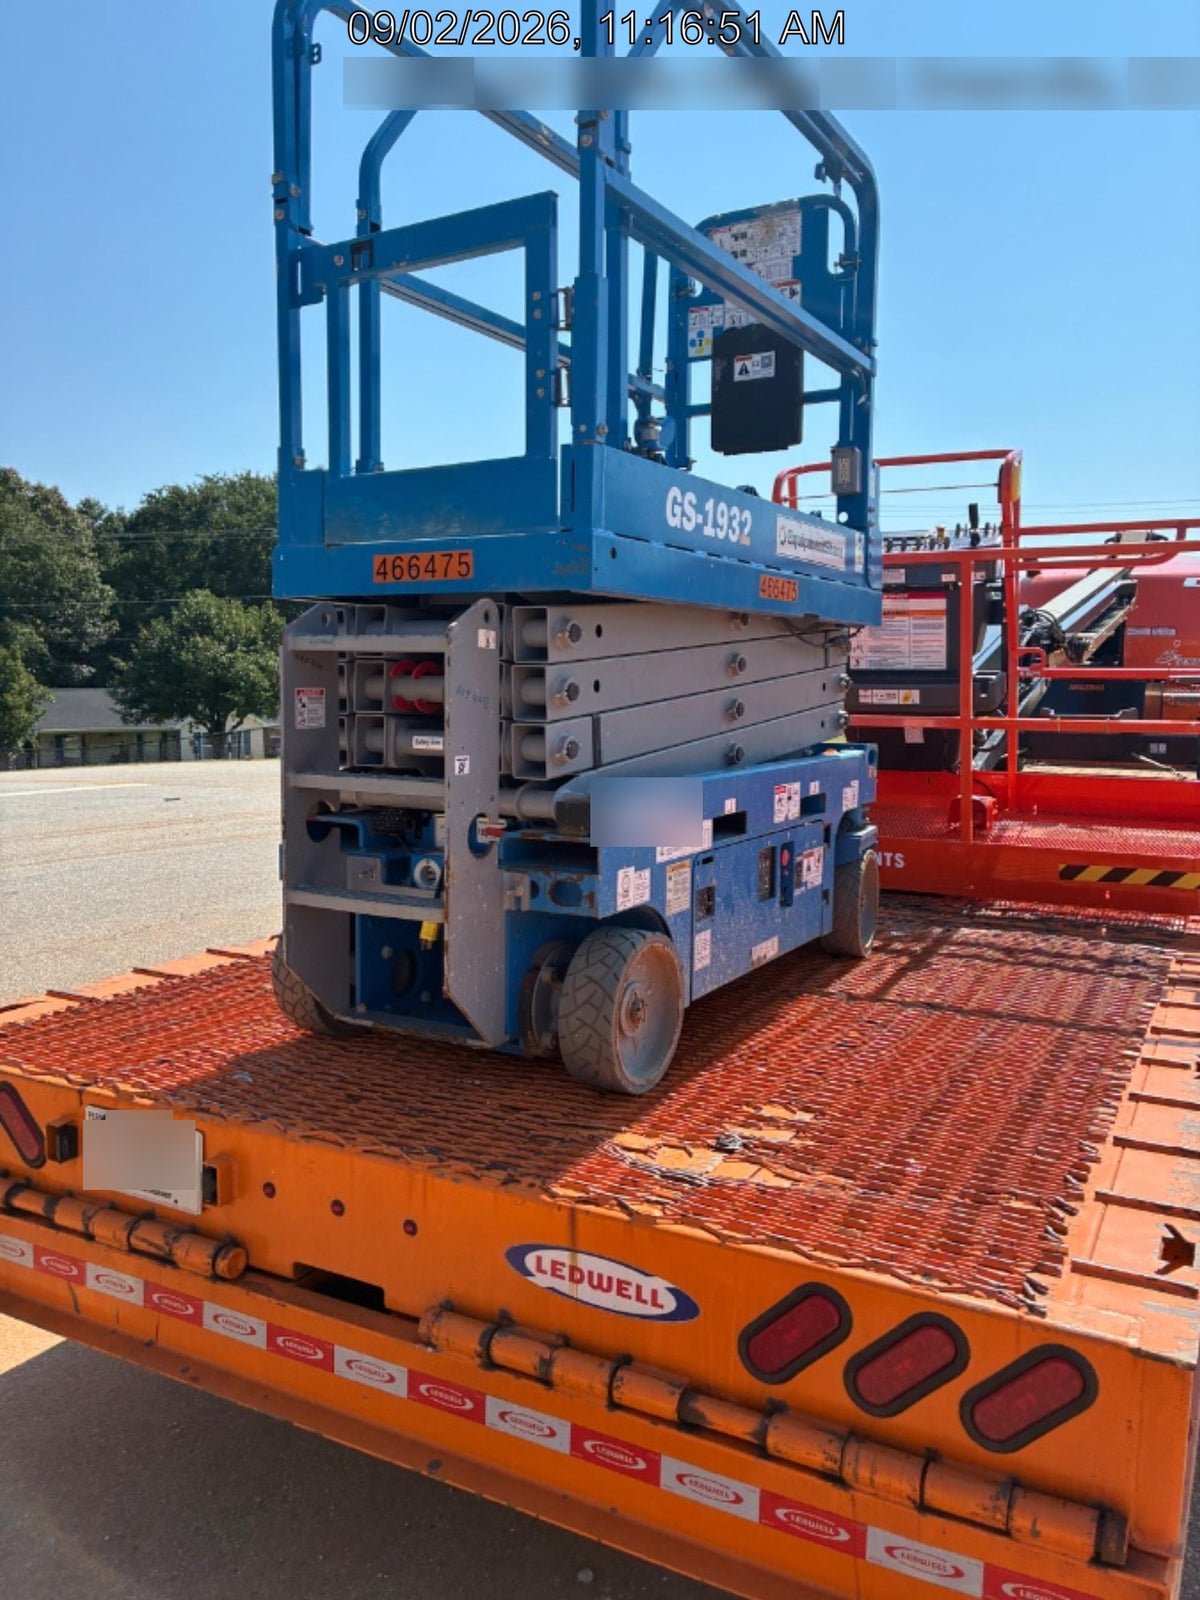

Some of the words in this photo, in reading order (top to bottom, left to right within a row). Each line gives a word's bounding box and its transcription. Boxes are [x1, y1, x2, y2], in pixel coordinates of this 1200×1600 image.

[666, 486, 752, 546] GS-1932
[376, 552, 470, 580] 466475
[535, 1255, 665, 1309] LEDWELL
